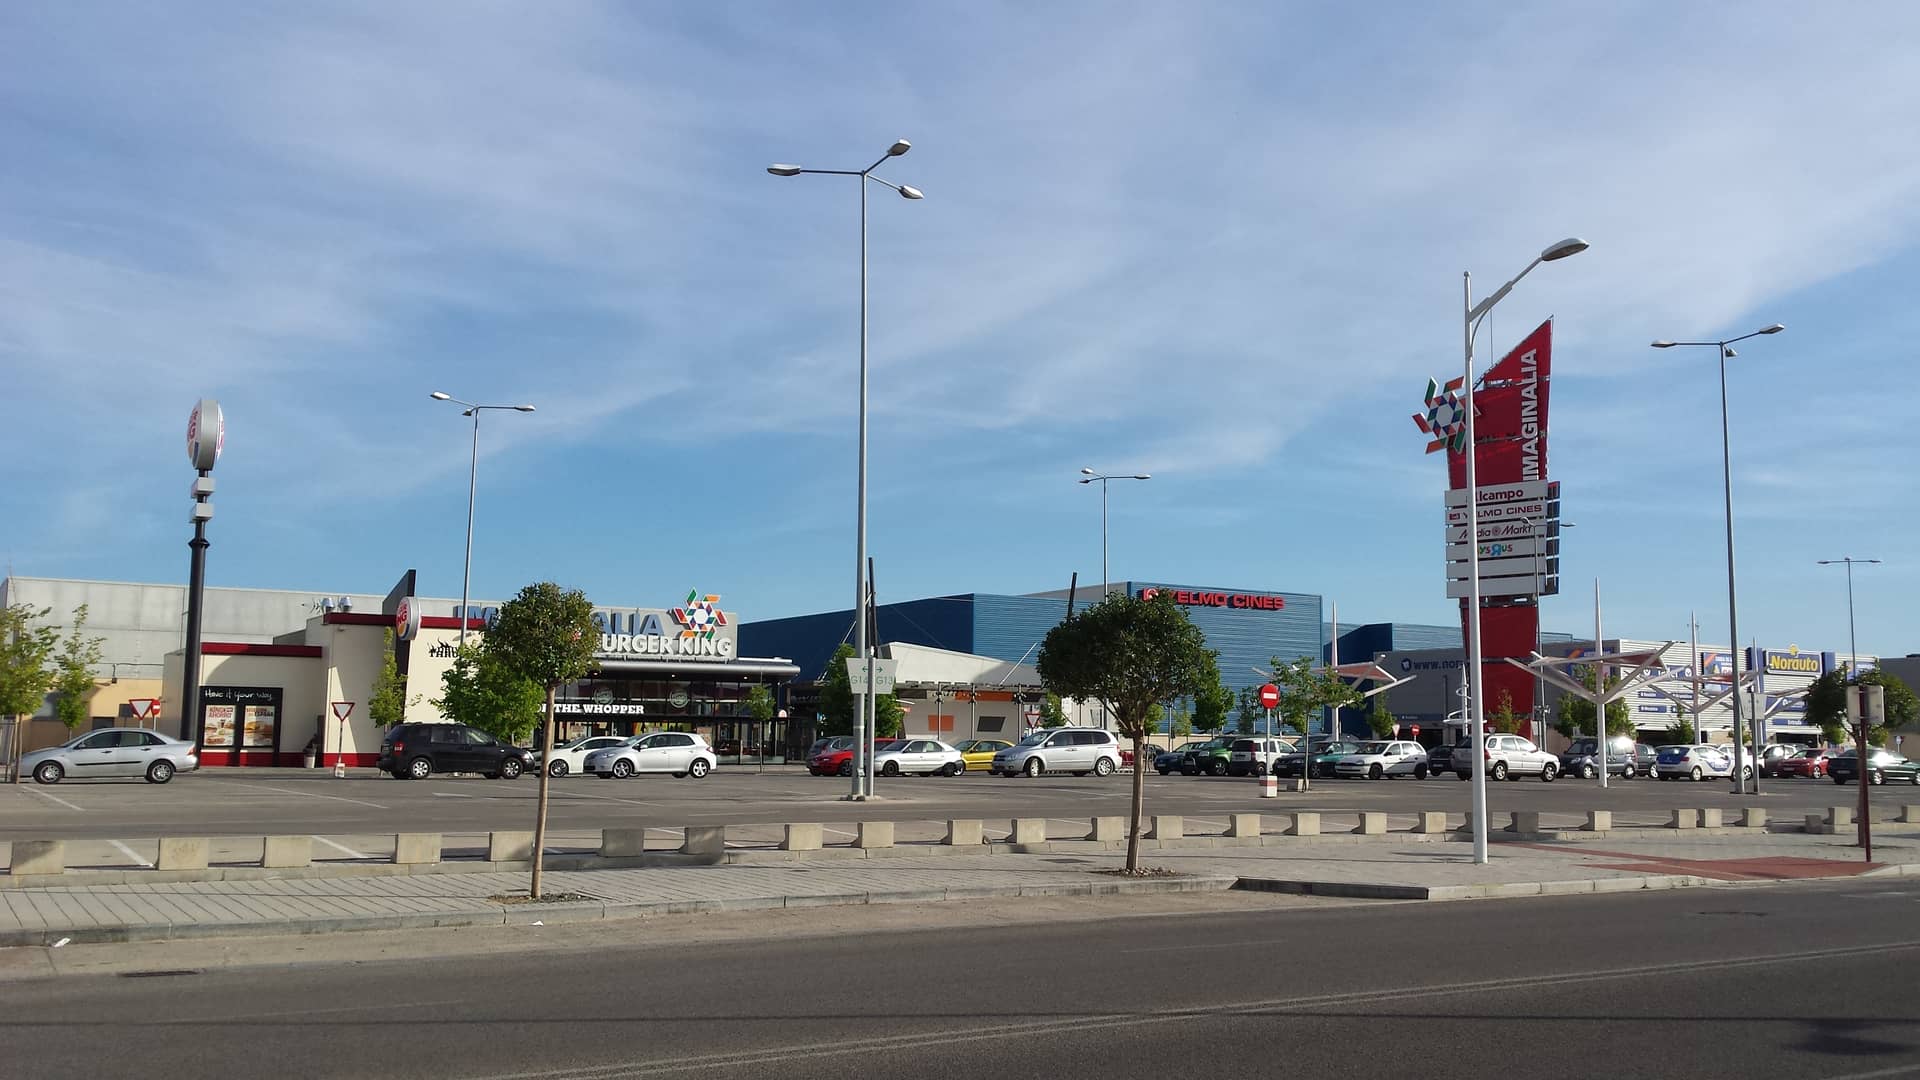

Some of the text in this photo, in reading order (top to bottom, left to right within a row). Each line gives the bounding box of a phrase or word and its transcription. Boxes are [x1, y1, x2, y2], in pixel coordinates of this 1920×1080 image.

[1521, 348, 1539, 481] IMAGINALIA
[1467, 488, 1524, 502] lcampo
[1463, 504, 1542, 519] LMO CINES
[1501, 525, 1532, 536] Markt
[1233, 593, 1285, 609] CINES
[597, 632, 732, 656] URGER KING
[1771, 655, 1819, 672] Norauto
[554, 703, 580, 713] THE
[582, 703, 645, 715] WHOPPER
